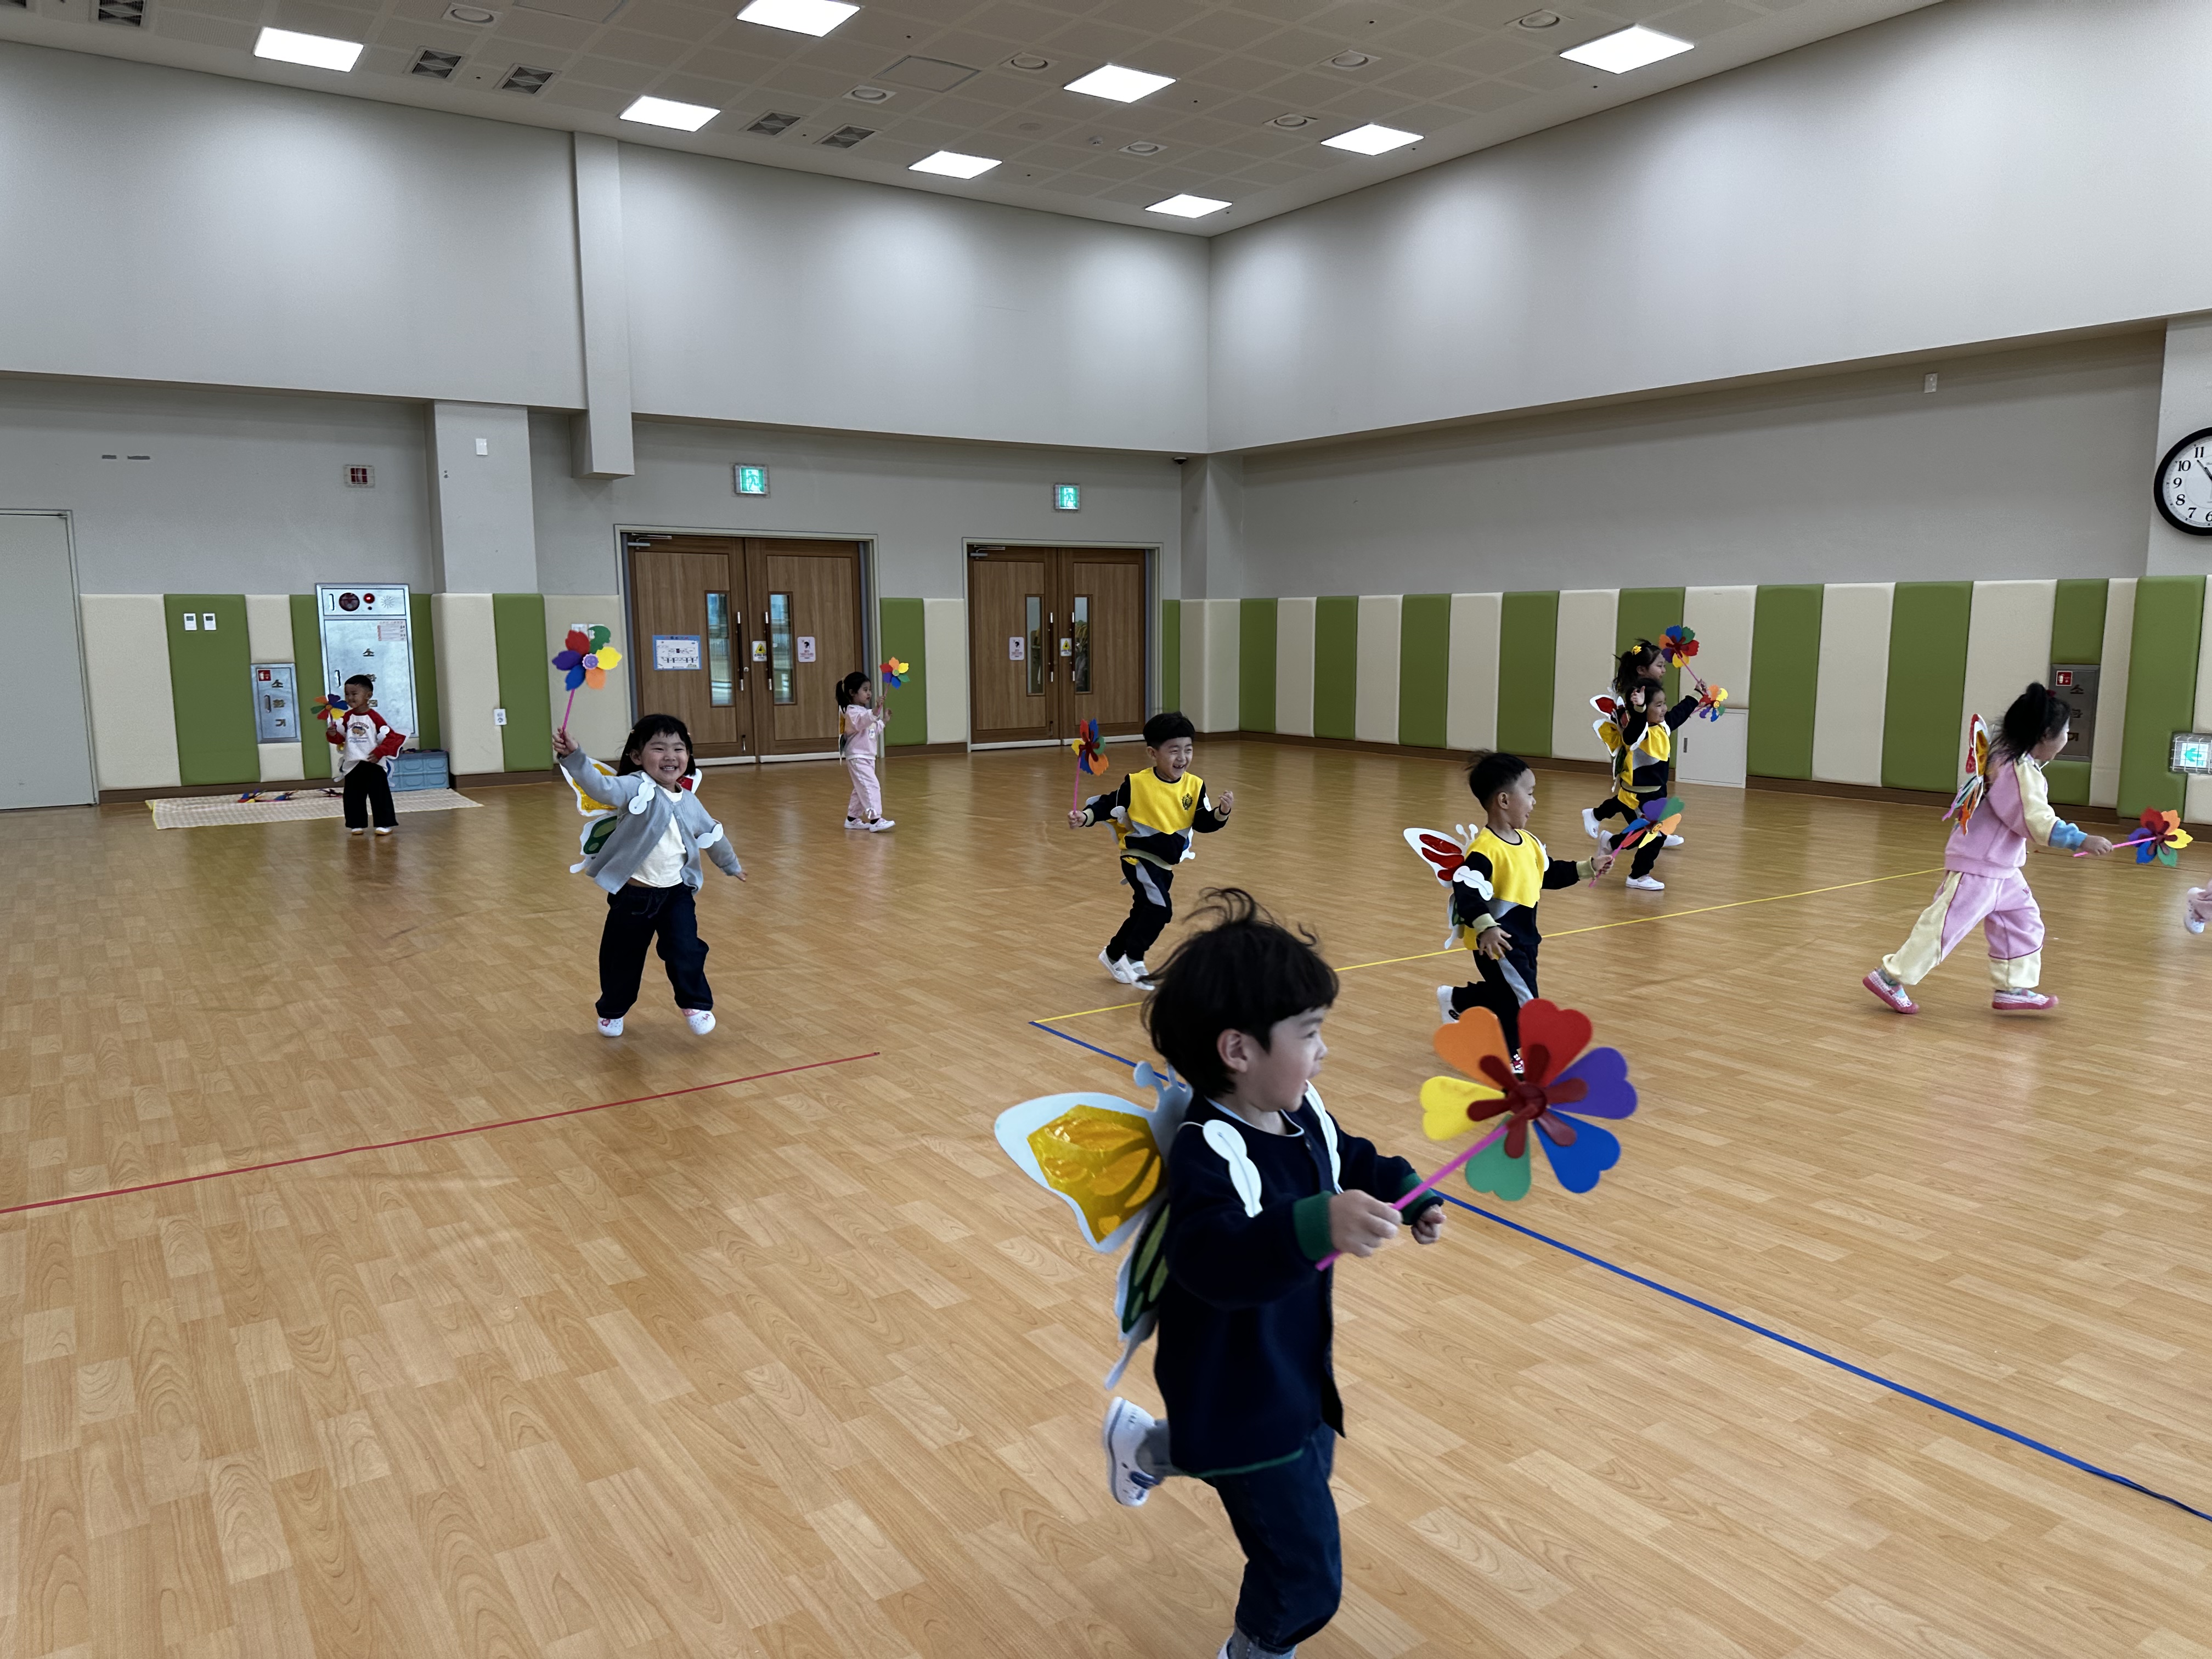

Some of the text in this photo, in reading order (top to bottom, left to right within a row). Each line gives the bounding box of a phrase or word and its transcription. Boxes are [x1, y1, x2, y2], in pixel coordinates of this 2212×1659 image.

[2194, 447, 2204, 458] 11
[2178, 460, 2191, 471] 10
[2173, 477, 2182, 489] 9
[2176, 494, 2185, 505] 8
[2188, 507, 2197, 518] 7
[2205, 511, 2212, 522] 6
